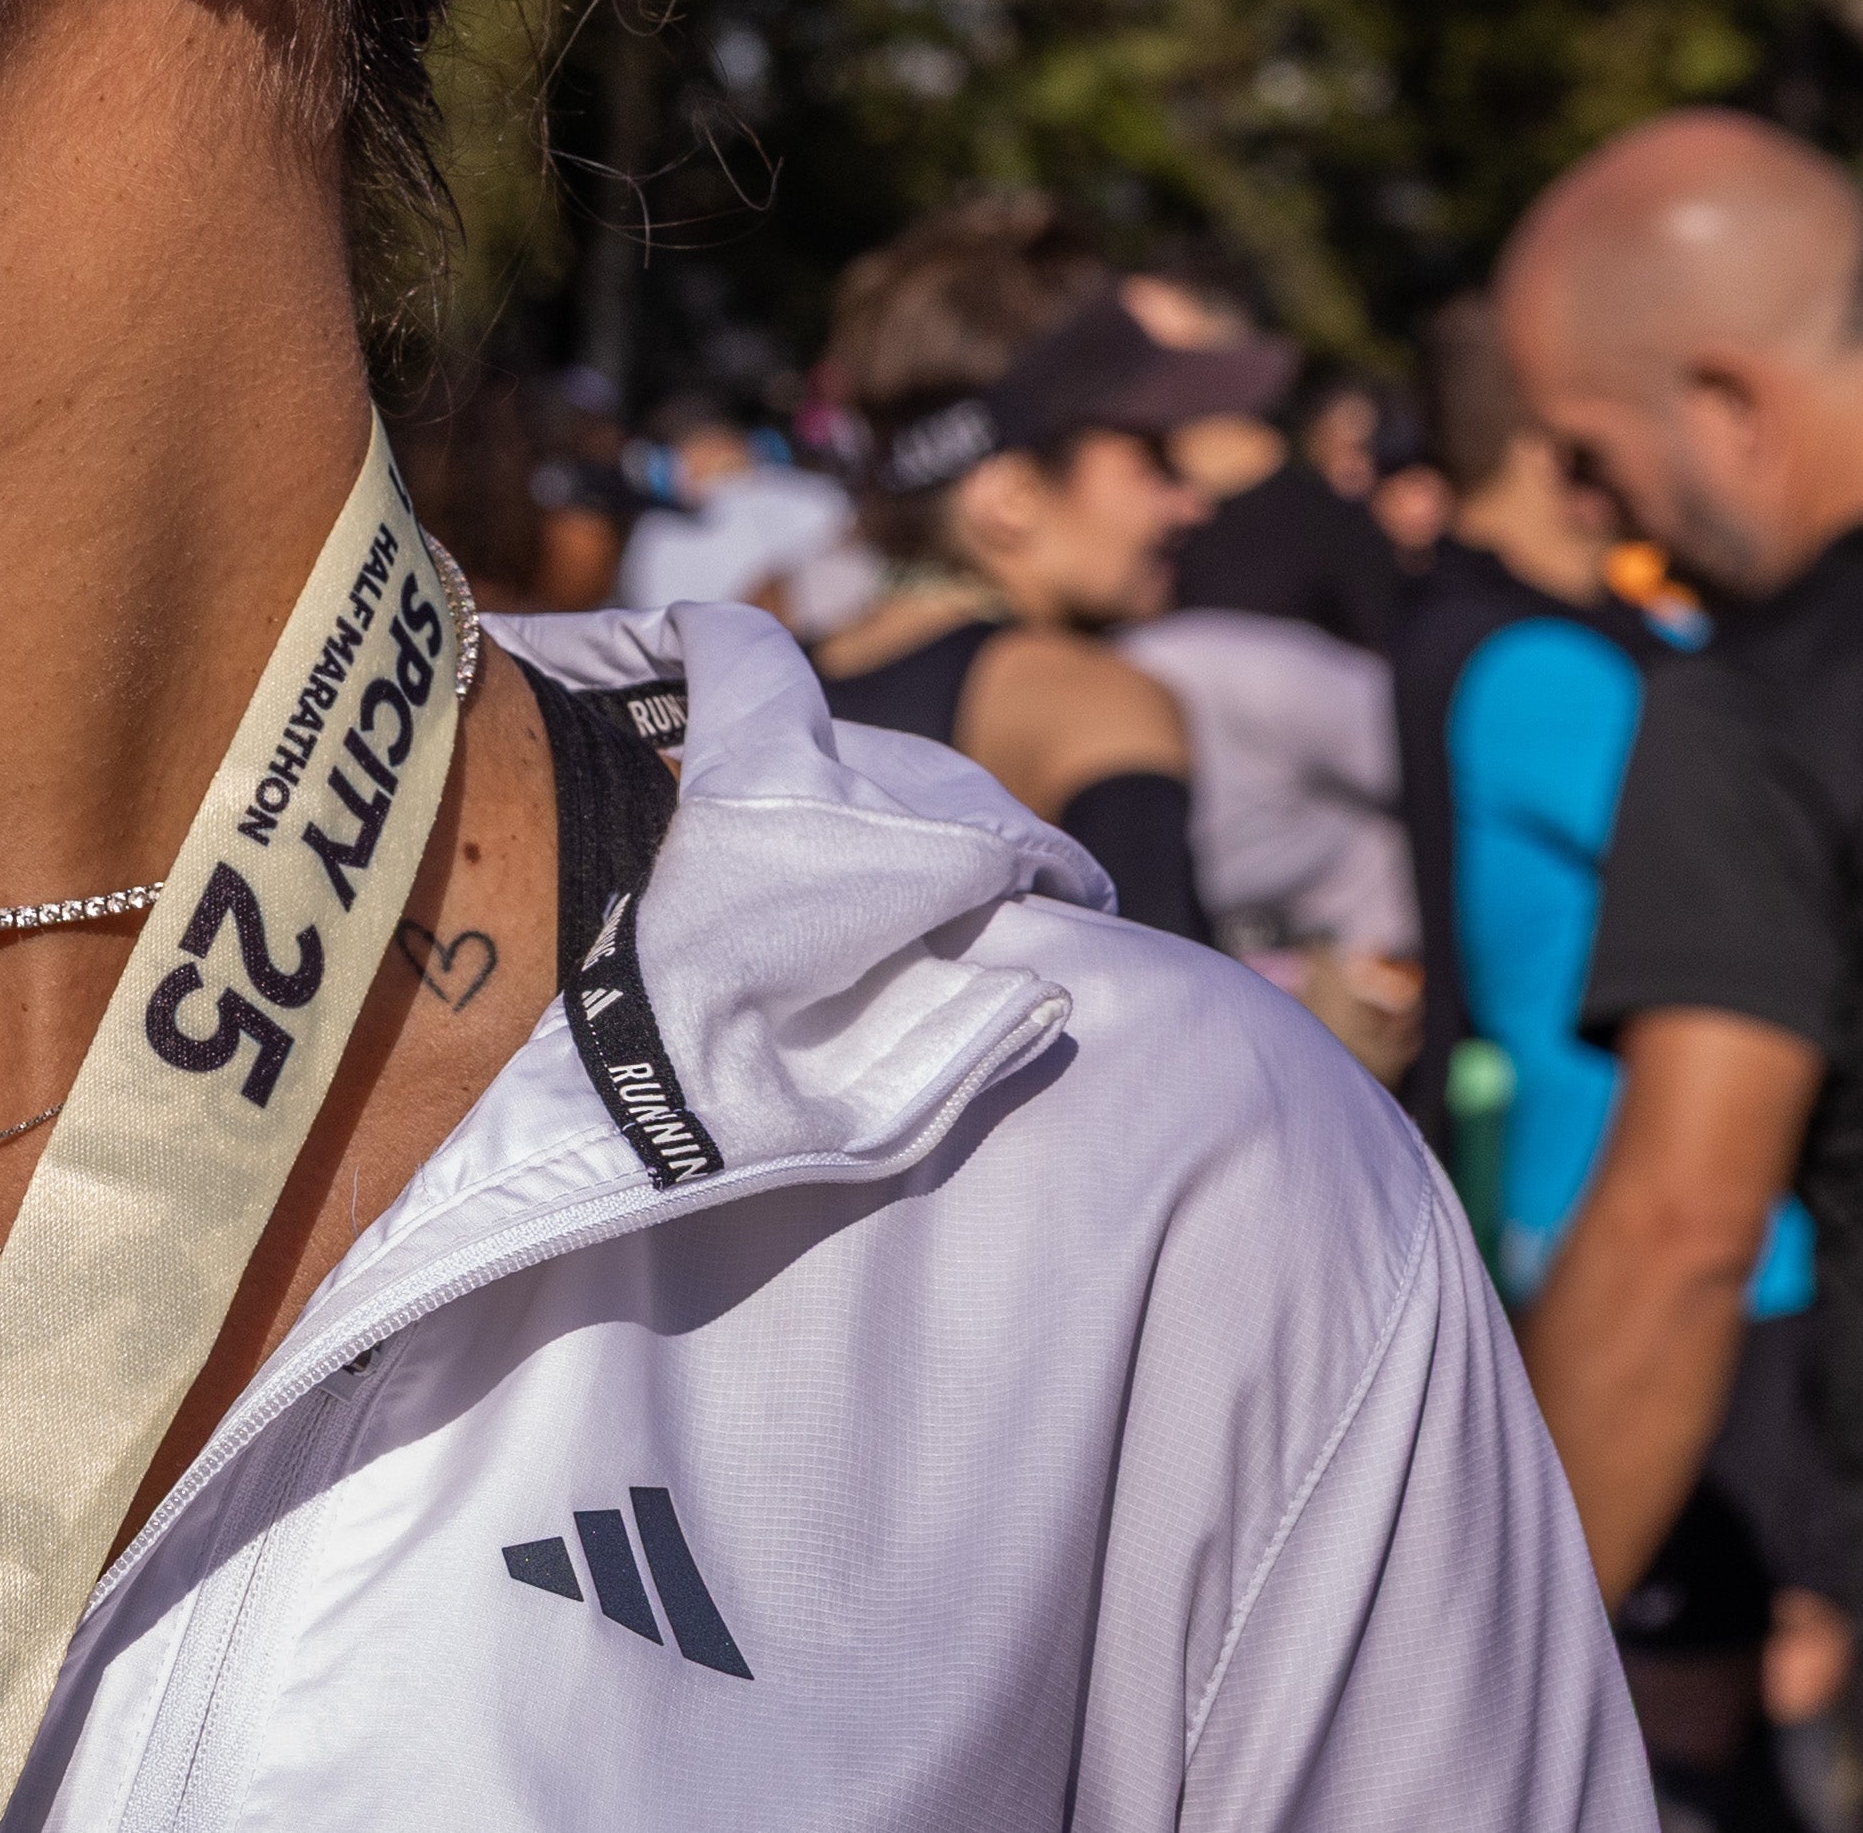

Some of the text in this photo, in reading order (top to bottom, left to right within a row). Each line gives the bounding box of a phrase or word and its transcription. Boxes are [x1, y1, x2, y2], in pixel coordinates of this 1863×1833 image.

[145, 572, 443, 1110] SPCITY 25
[237, 522, 398, 848] HALF MARATHON
